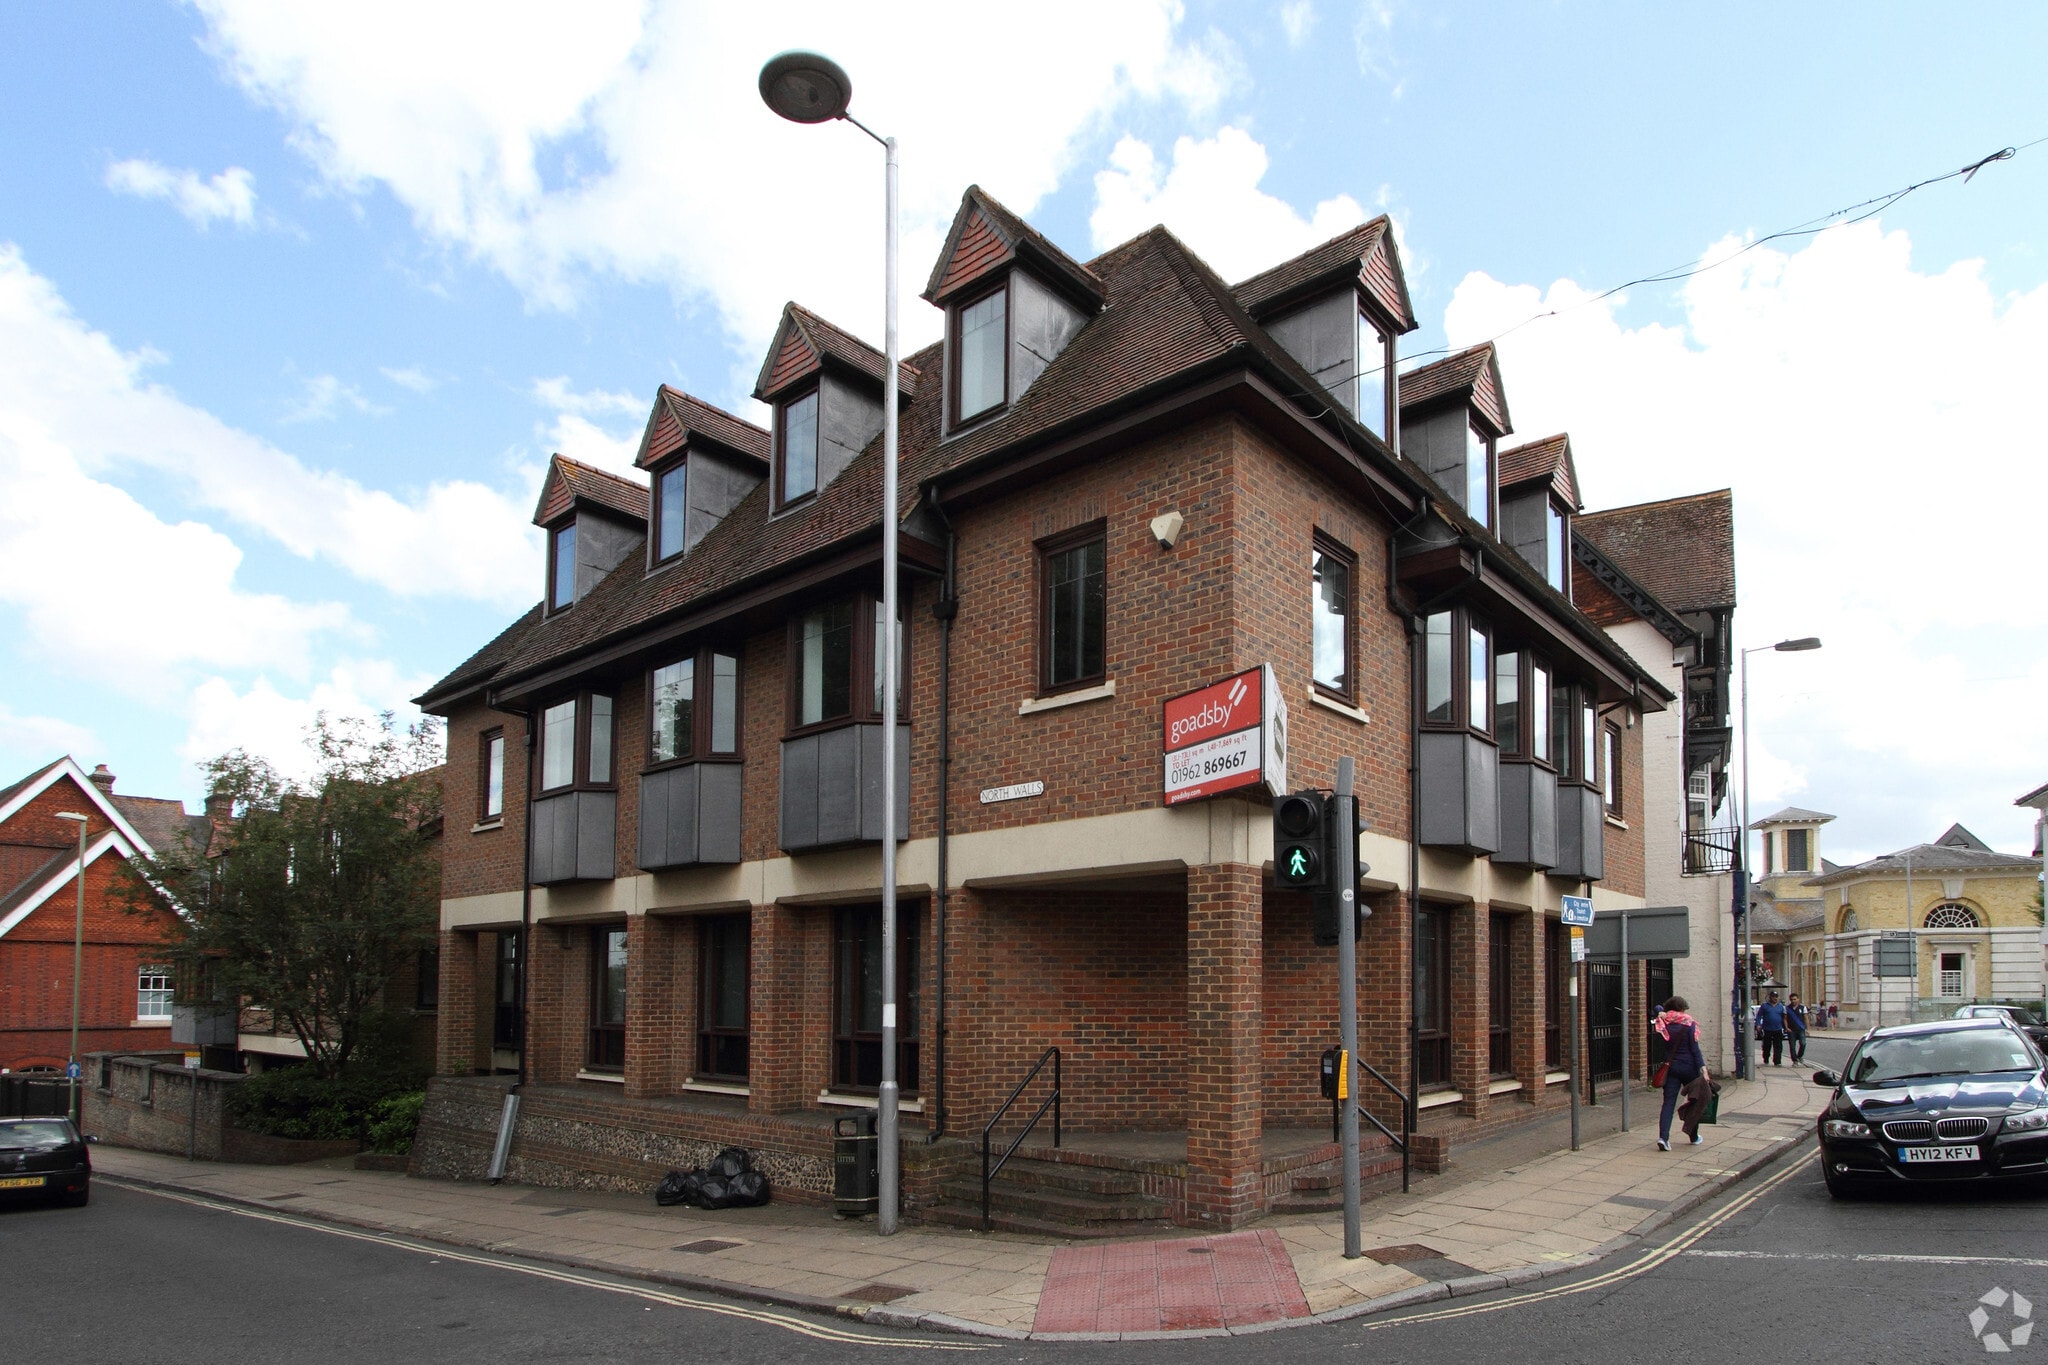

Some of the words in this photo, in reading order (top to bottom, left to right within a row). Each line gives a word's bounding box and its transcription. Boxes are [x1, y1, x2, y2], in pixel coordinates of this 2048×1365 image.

[1171, 700, 1232, 743] goadsby
[1172, 761, 1180, 769] TO
[1182, 759, 1190, 767] LET
[1172, 764, 1200, 784] 01962
[1204, 750, 1247, 775] 869667
[982, 788, 1009, 800] NORTH
[1014, 782, 1042, 795] WALLS
[1171, 789, 1201, 803] goadsby.com
[837, 1155, 856, 1163] LITTER
[1909, 1148, 1942, 1160] HY12
[1945, 1147, 1972, 1159] KFV
